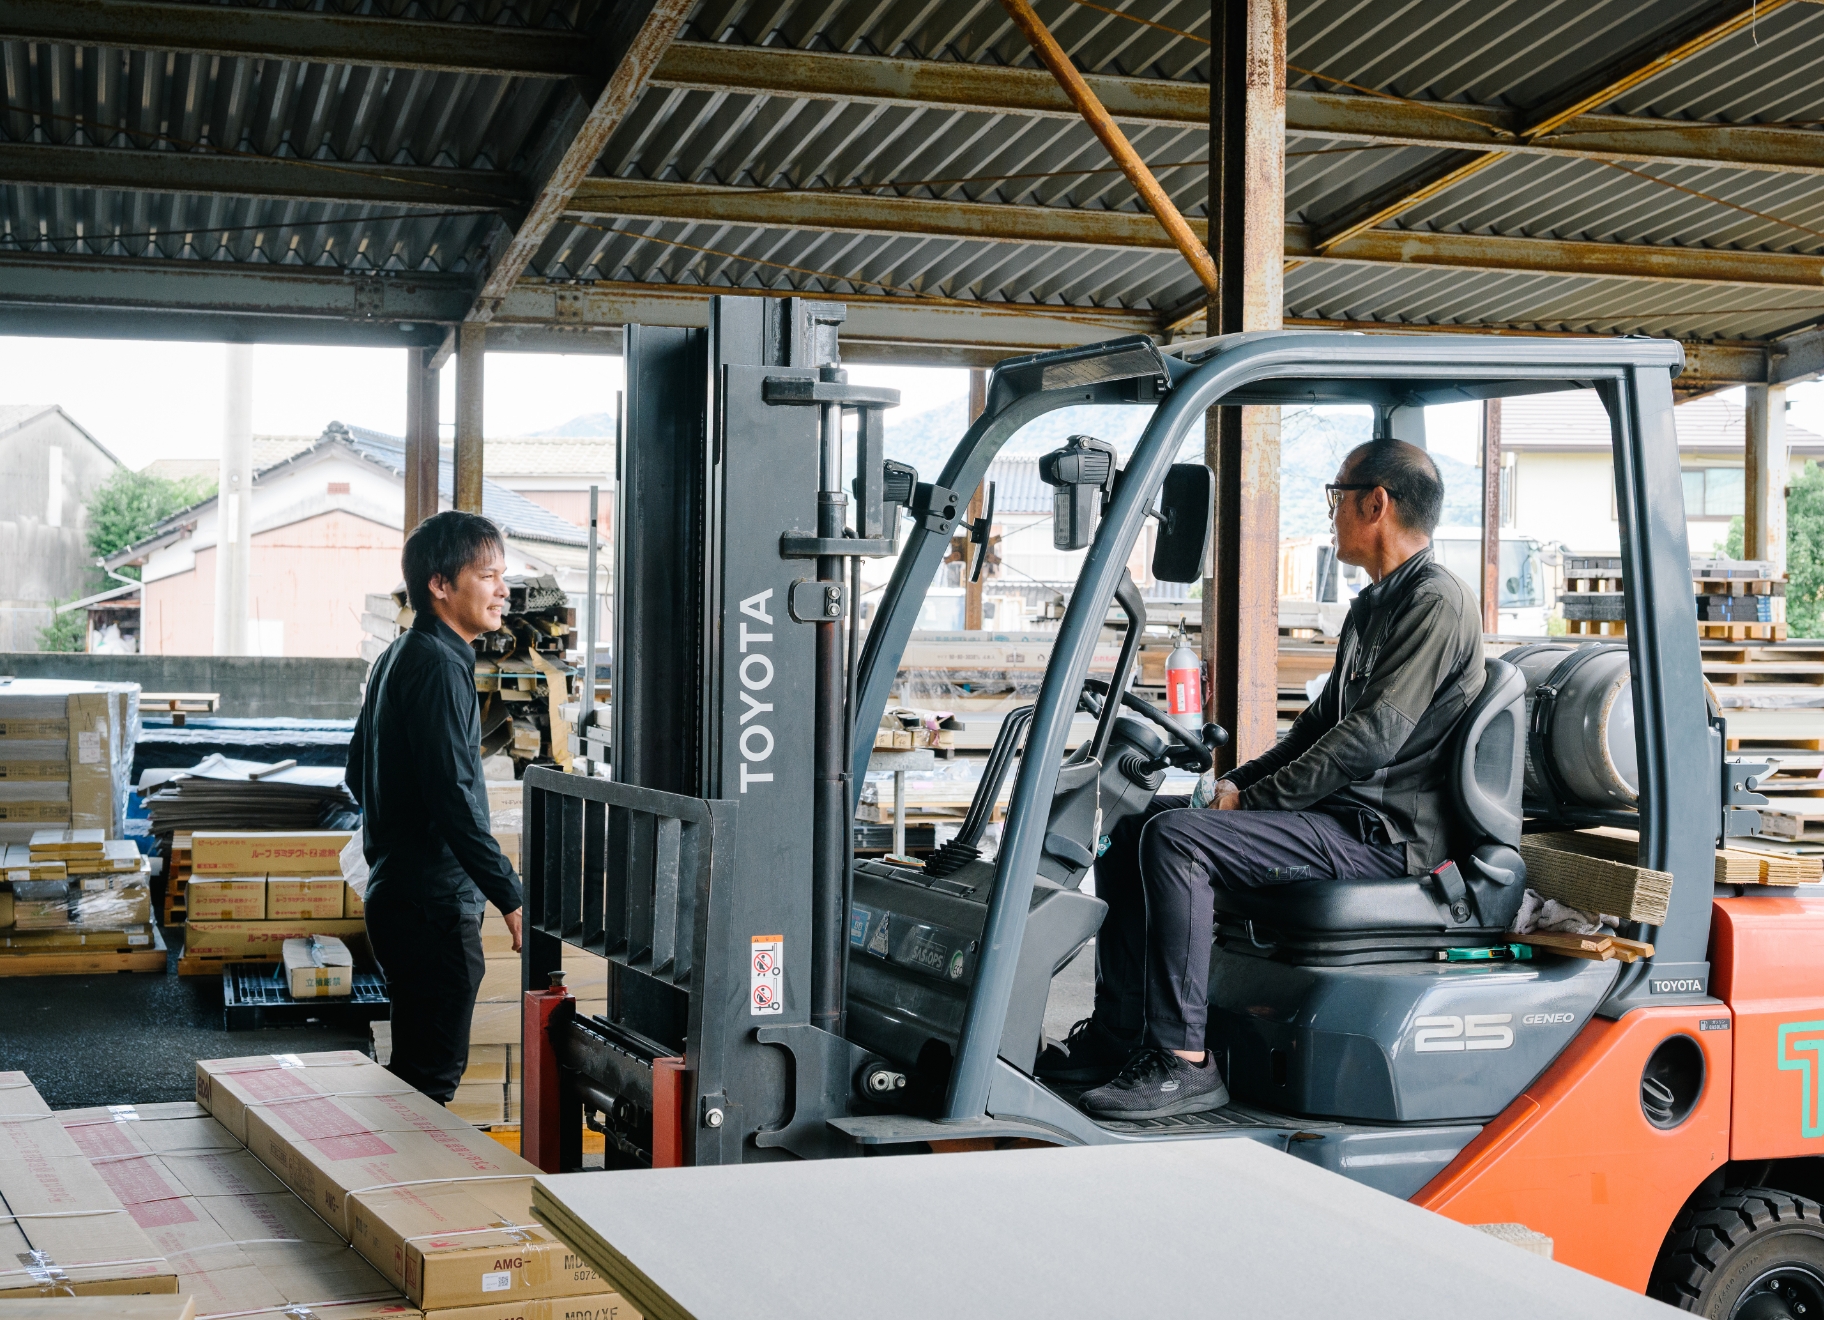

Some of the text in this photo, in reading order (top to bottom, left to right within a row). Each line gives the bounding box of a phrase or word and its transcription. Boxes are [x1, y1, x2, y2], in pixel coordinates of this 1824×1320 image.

[739, 588, 774, 793] TOYOTA
[1654, 979, 1702, 992] TOYOTA
[1414, 1013, 1575, 1052] 25 GENEO
